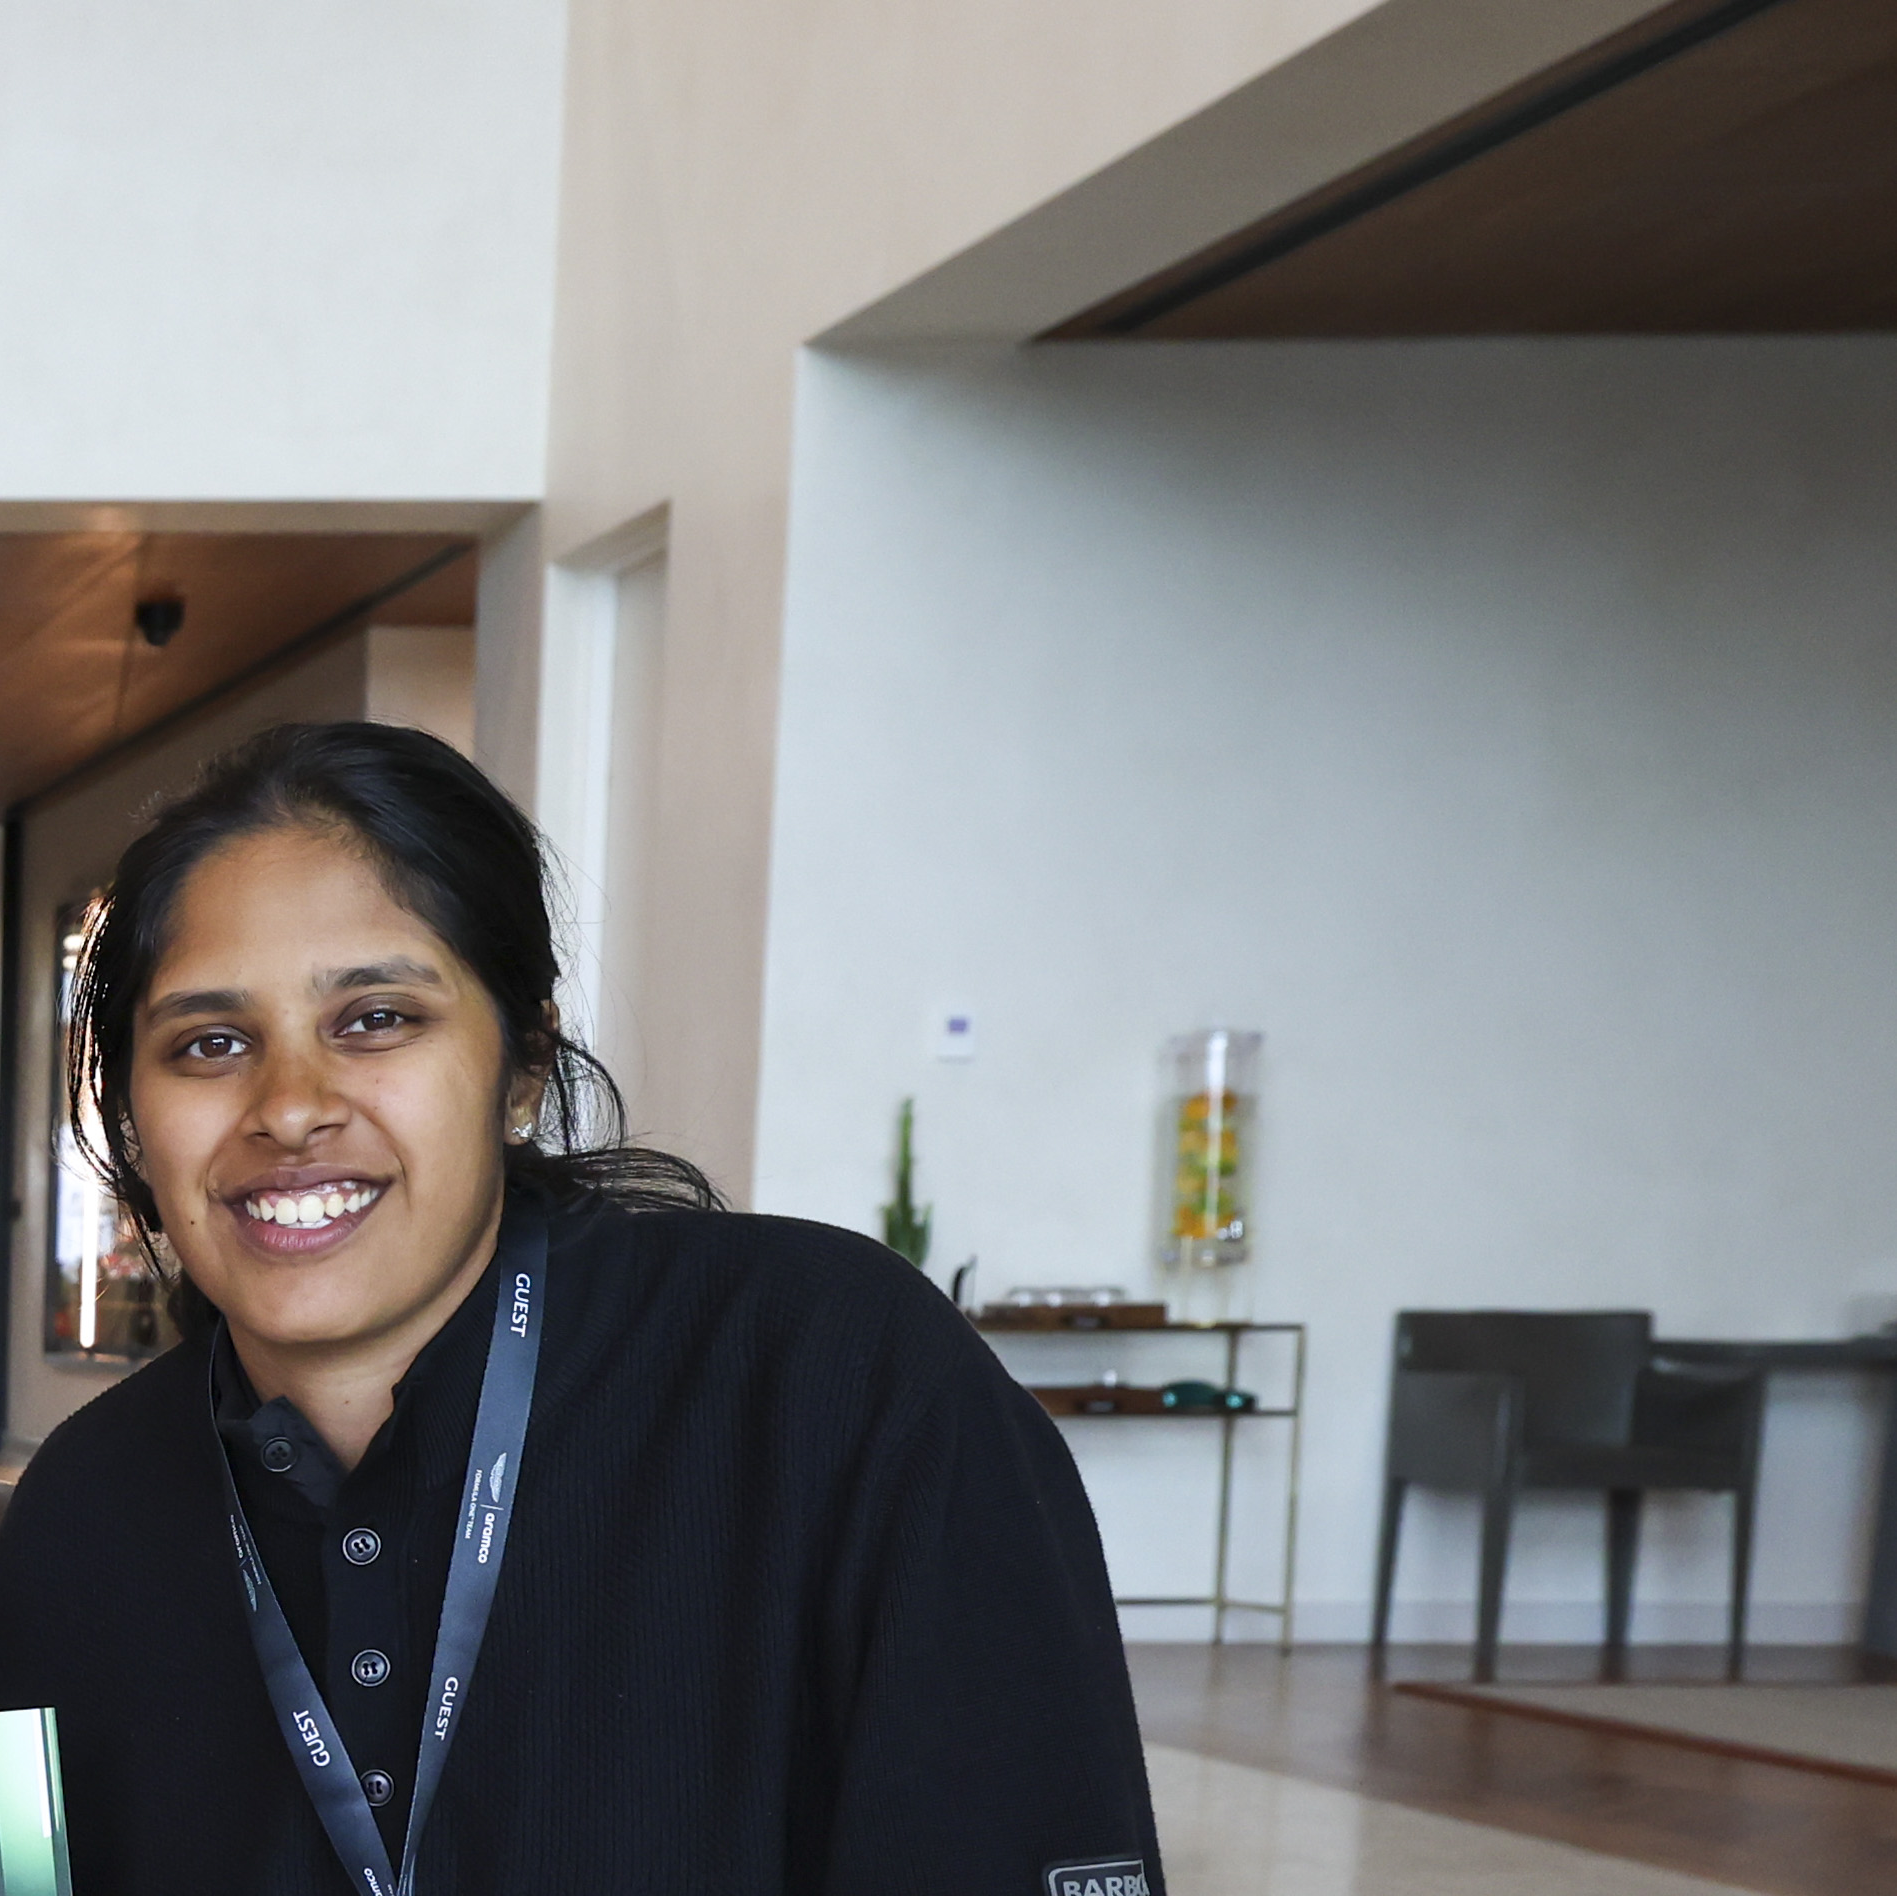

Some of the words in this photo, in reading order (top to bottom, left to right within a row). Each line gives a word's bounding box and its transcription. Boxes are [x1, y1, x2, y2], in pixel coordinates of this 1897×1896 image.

[511, 1273, 530, 1337] GUEST
[478, 1512, 495, 1564] aramco
[434, 1676, 458, 1740] GUEST
[293, 1710, 330, 1767] GUEST
